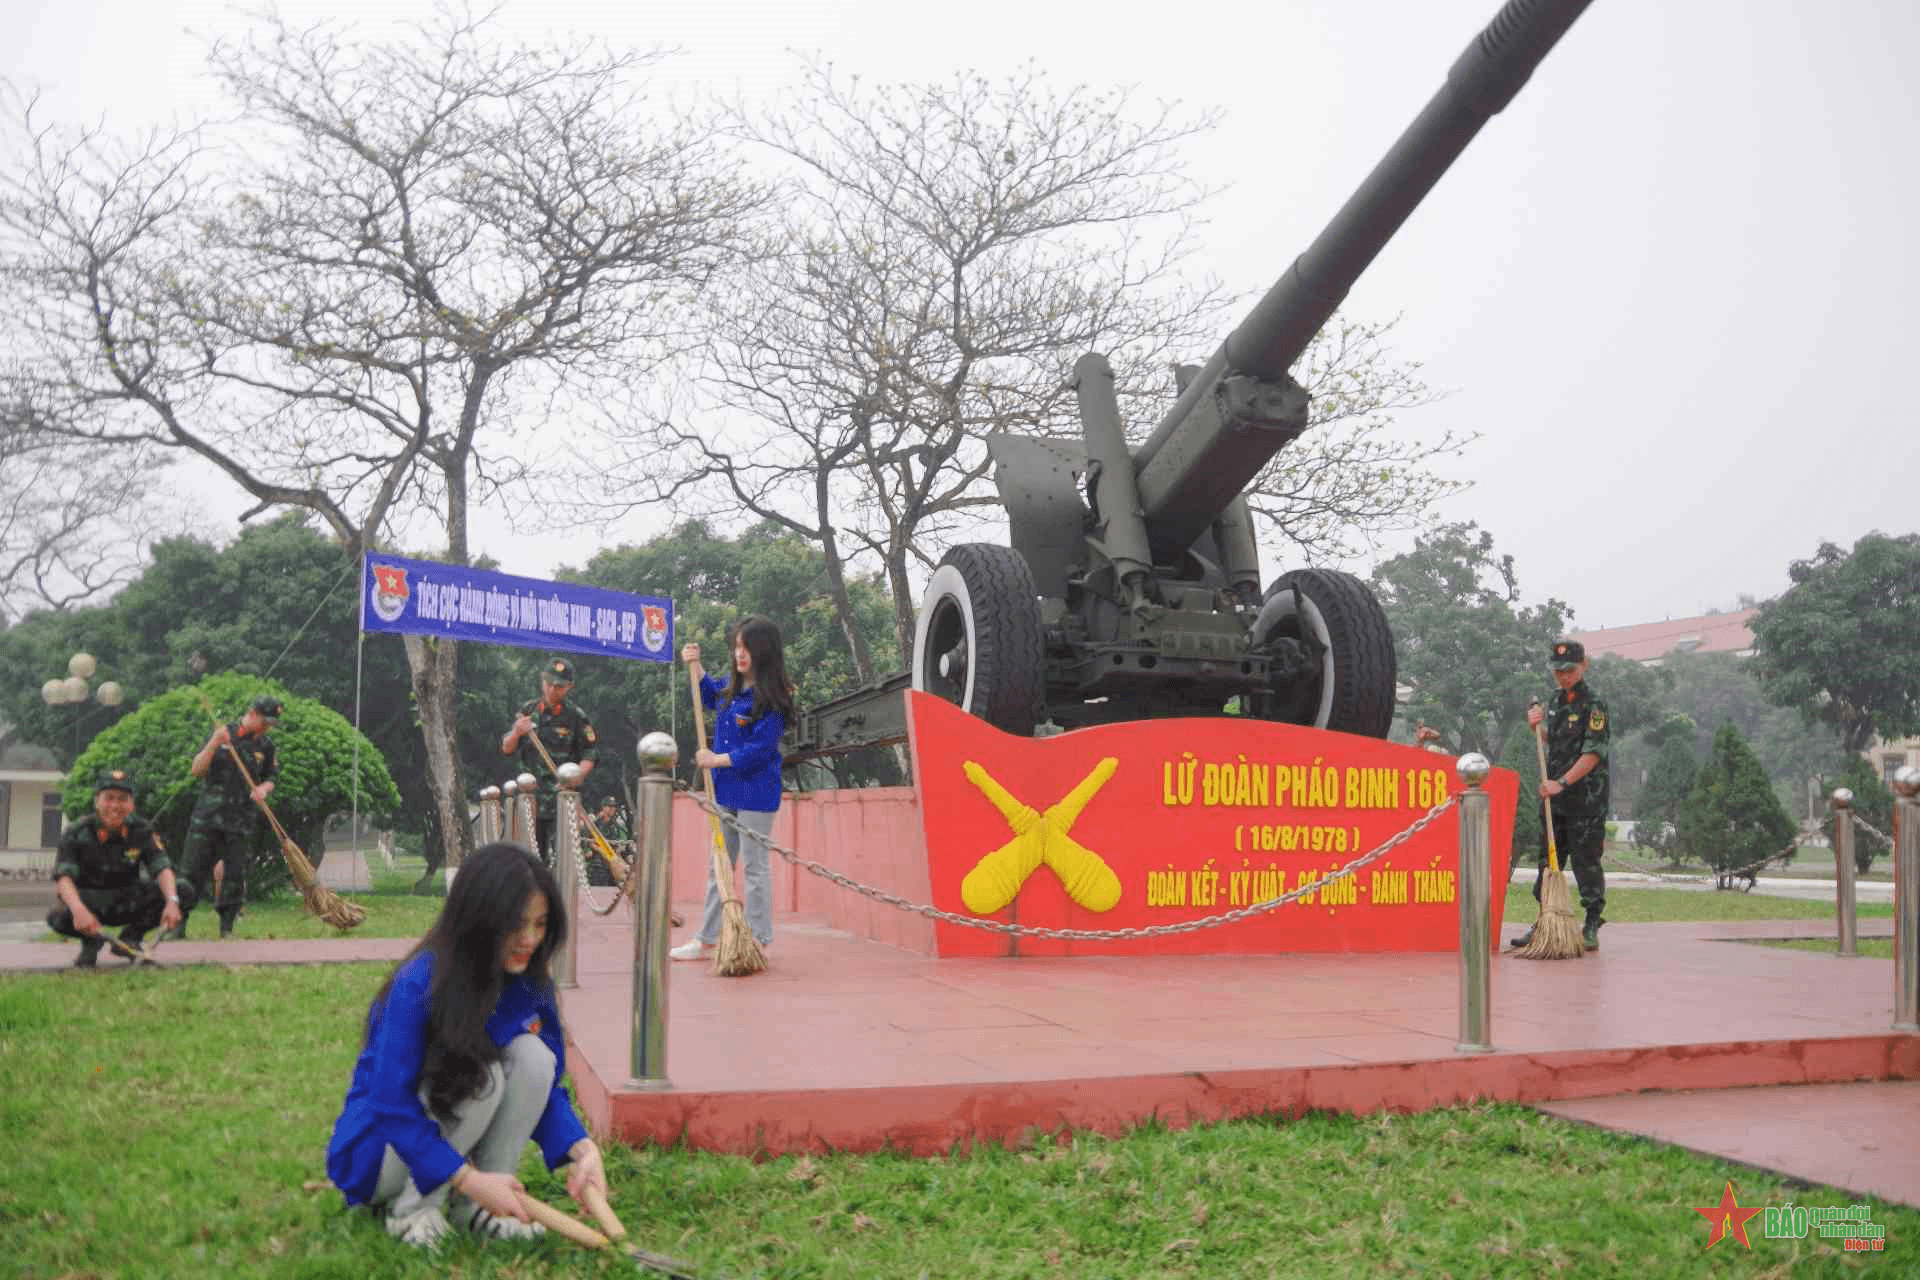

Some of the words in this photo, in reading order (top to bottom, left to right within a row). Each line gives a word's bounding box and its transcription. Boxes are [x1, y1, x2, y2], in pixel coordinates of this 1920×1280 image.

[417, 576, 439, 620] TÍCH
[439, 583, 459, 629] CỰC
[459, 581, 484, 625] HÀNH
[509, 588, 520, 630] VÌ
[570, 603, 591, 638] XANH
[596, 607, 617, 646] SẠCH
[622, 611, 637, 649] ĐẸP
[1163, 751, 1199, 806] LỮ
[1202, 754, 1270, 807] ĐOÀN
[1275, 756, 1339, 808] PHÁO
[1345, 767, 1399, 808] BINH
[1406, 768, 1448, 808] 168
[1146, 863, 1187, 906] ĐOÀN
[1191, 858, 1220, 906] KẾT
[1229, 858, 1250, 905] KỶ
[1251, 863, 1287, 914] LUẬT
[1297, 868, 1318, 906] CƠ
[1320, 863, 1358, 914] ĐỘNG
[1371, 861, 1409, 905] ĐÁNH
[1413, 855, 1456, 904] THẮNG
